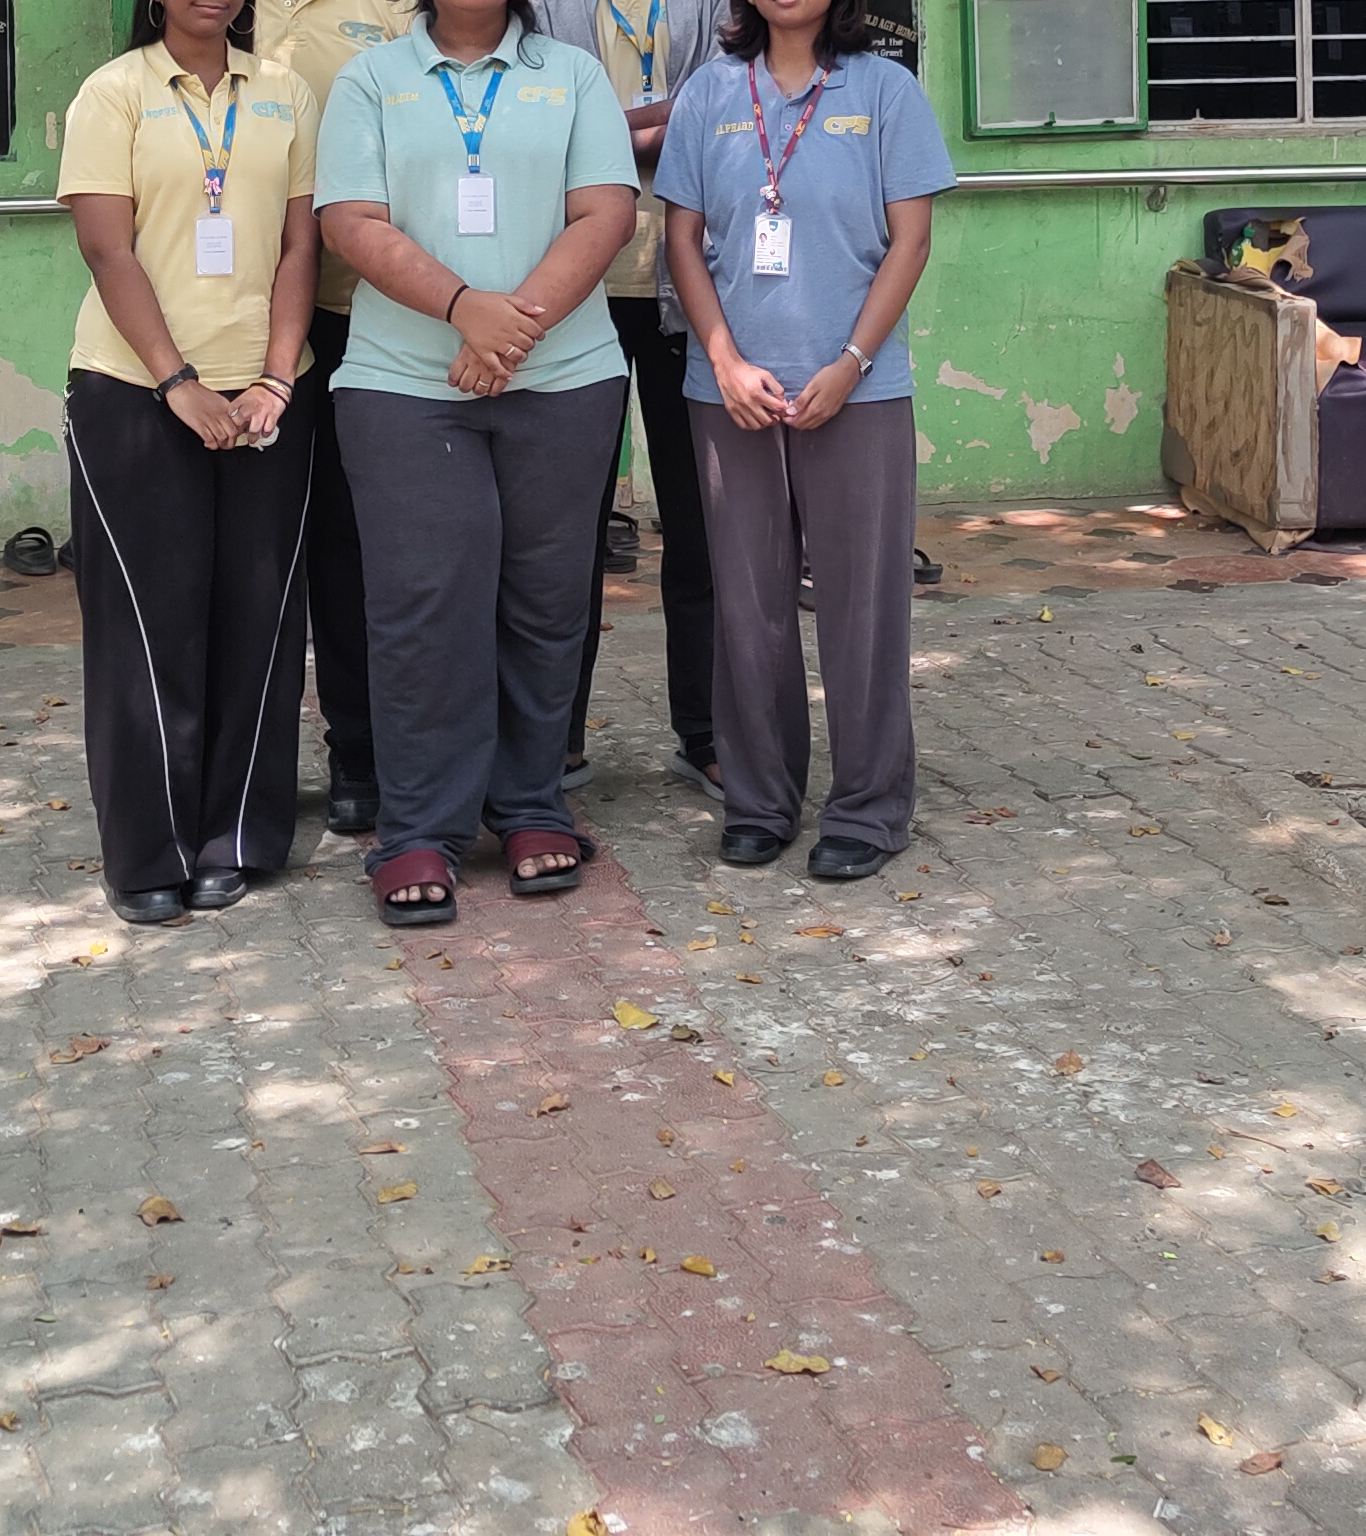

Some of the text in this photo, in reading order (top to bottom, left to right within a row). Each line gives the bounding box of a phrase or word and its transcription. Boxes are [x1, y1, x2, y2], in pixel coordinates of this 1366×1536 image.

[878, 18, 897, 33] AGE
[895, 24, 918, 43] HOME
[889, 37, 903, 46] the
[880, 48, 904, 58] Grant
[517, 86, 568, 106] CPS
[823, 114, 872, 135] CPS
